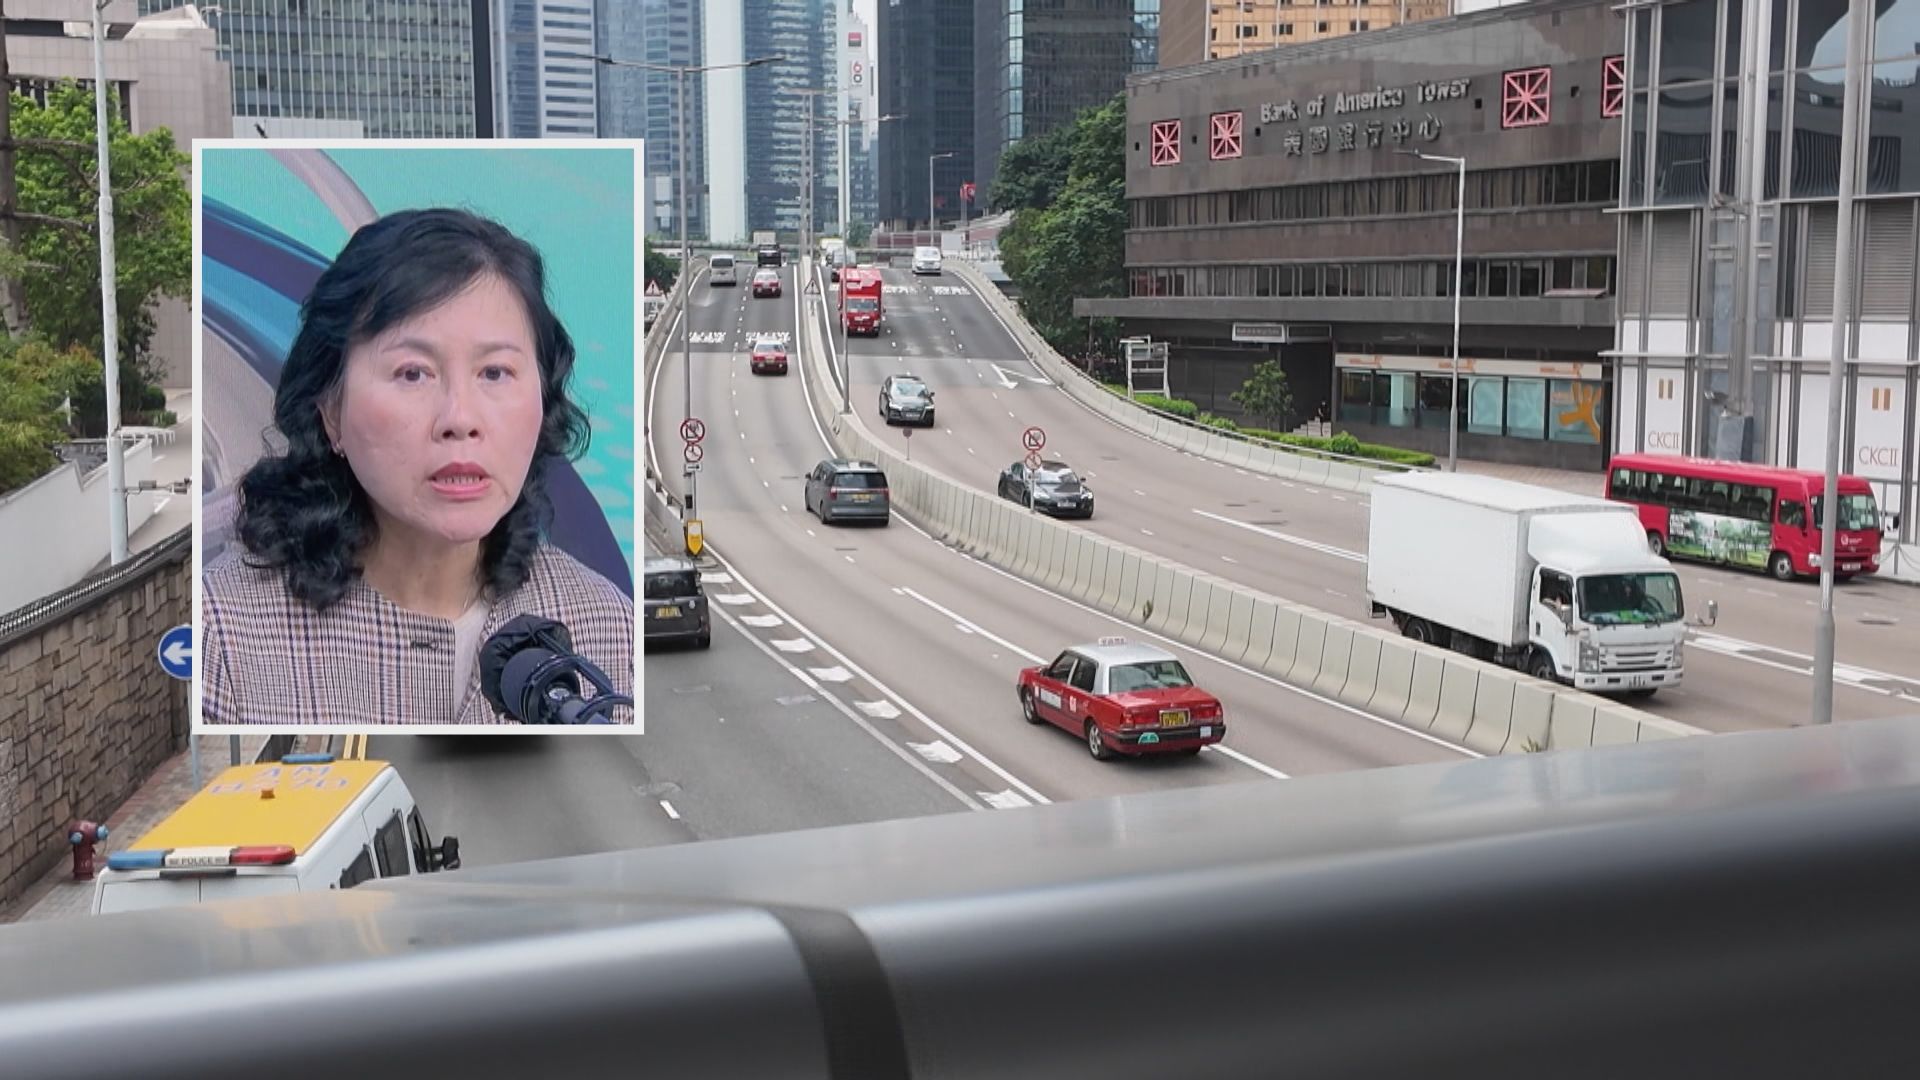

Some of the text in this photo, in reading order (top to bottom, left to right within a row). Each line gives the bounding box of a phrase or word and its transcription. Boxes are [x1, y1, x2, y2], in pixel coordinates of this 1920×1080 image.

[1260, 77, 1471, 124] Bank of America Tower
[181, 855, 212, 865] POLICE
